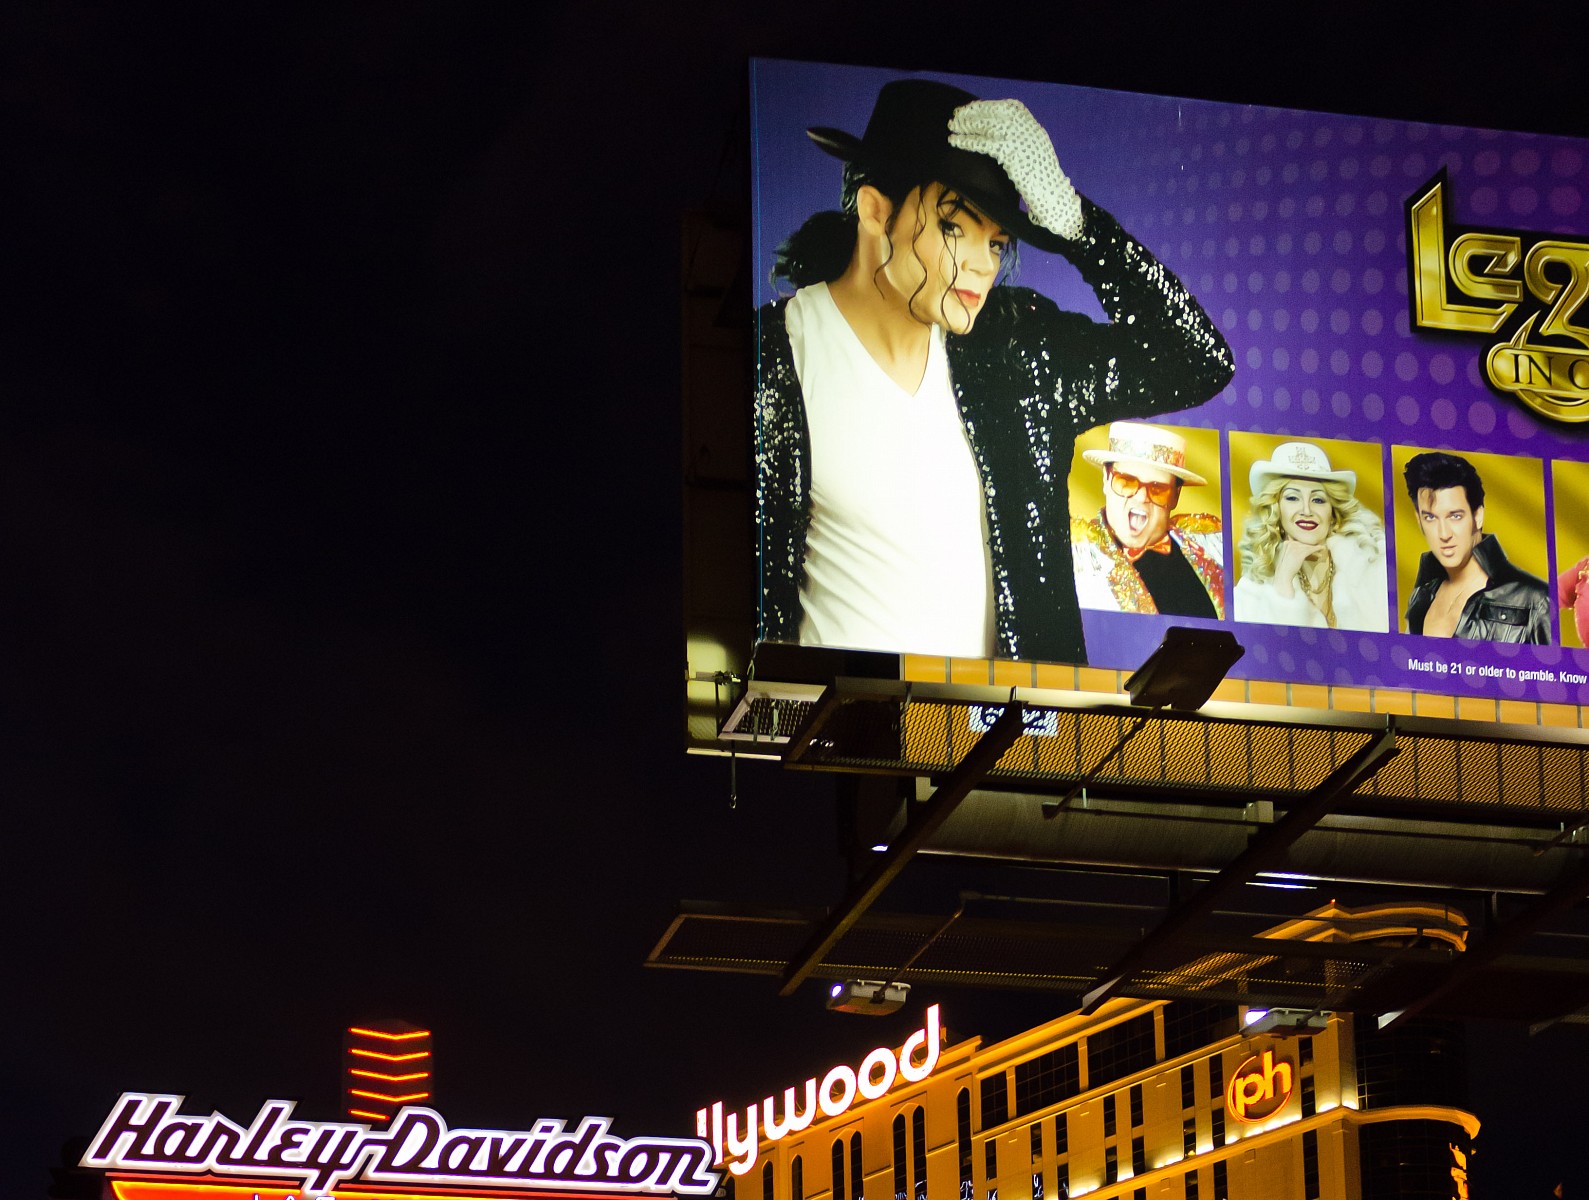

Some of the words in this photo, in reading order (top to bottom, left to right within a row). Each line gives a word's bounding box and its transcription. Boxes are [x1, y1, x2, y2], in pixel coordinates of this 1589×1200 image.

[1512, 352, 1552, 386] IN
[1408, 659, 1433, 672] Must
[1435, 661, 1448, 673] be
[1450, 662, 1462, 675] 21
[1465, 665, 1477, 676] or
[1479, 665, 1503, 678] older
[1505, 668, 1516, 679] to
[1518, 670, 1557, 682] gamble.
[1559, 671, 1588, 684] Know
[1233, 1051, 1292, 1114] ph
[80, 1092, 724, 1195] Harley-Davidson
